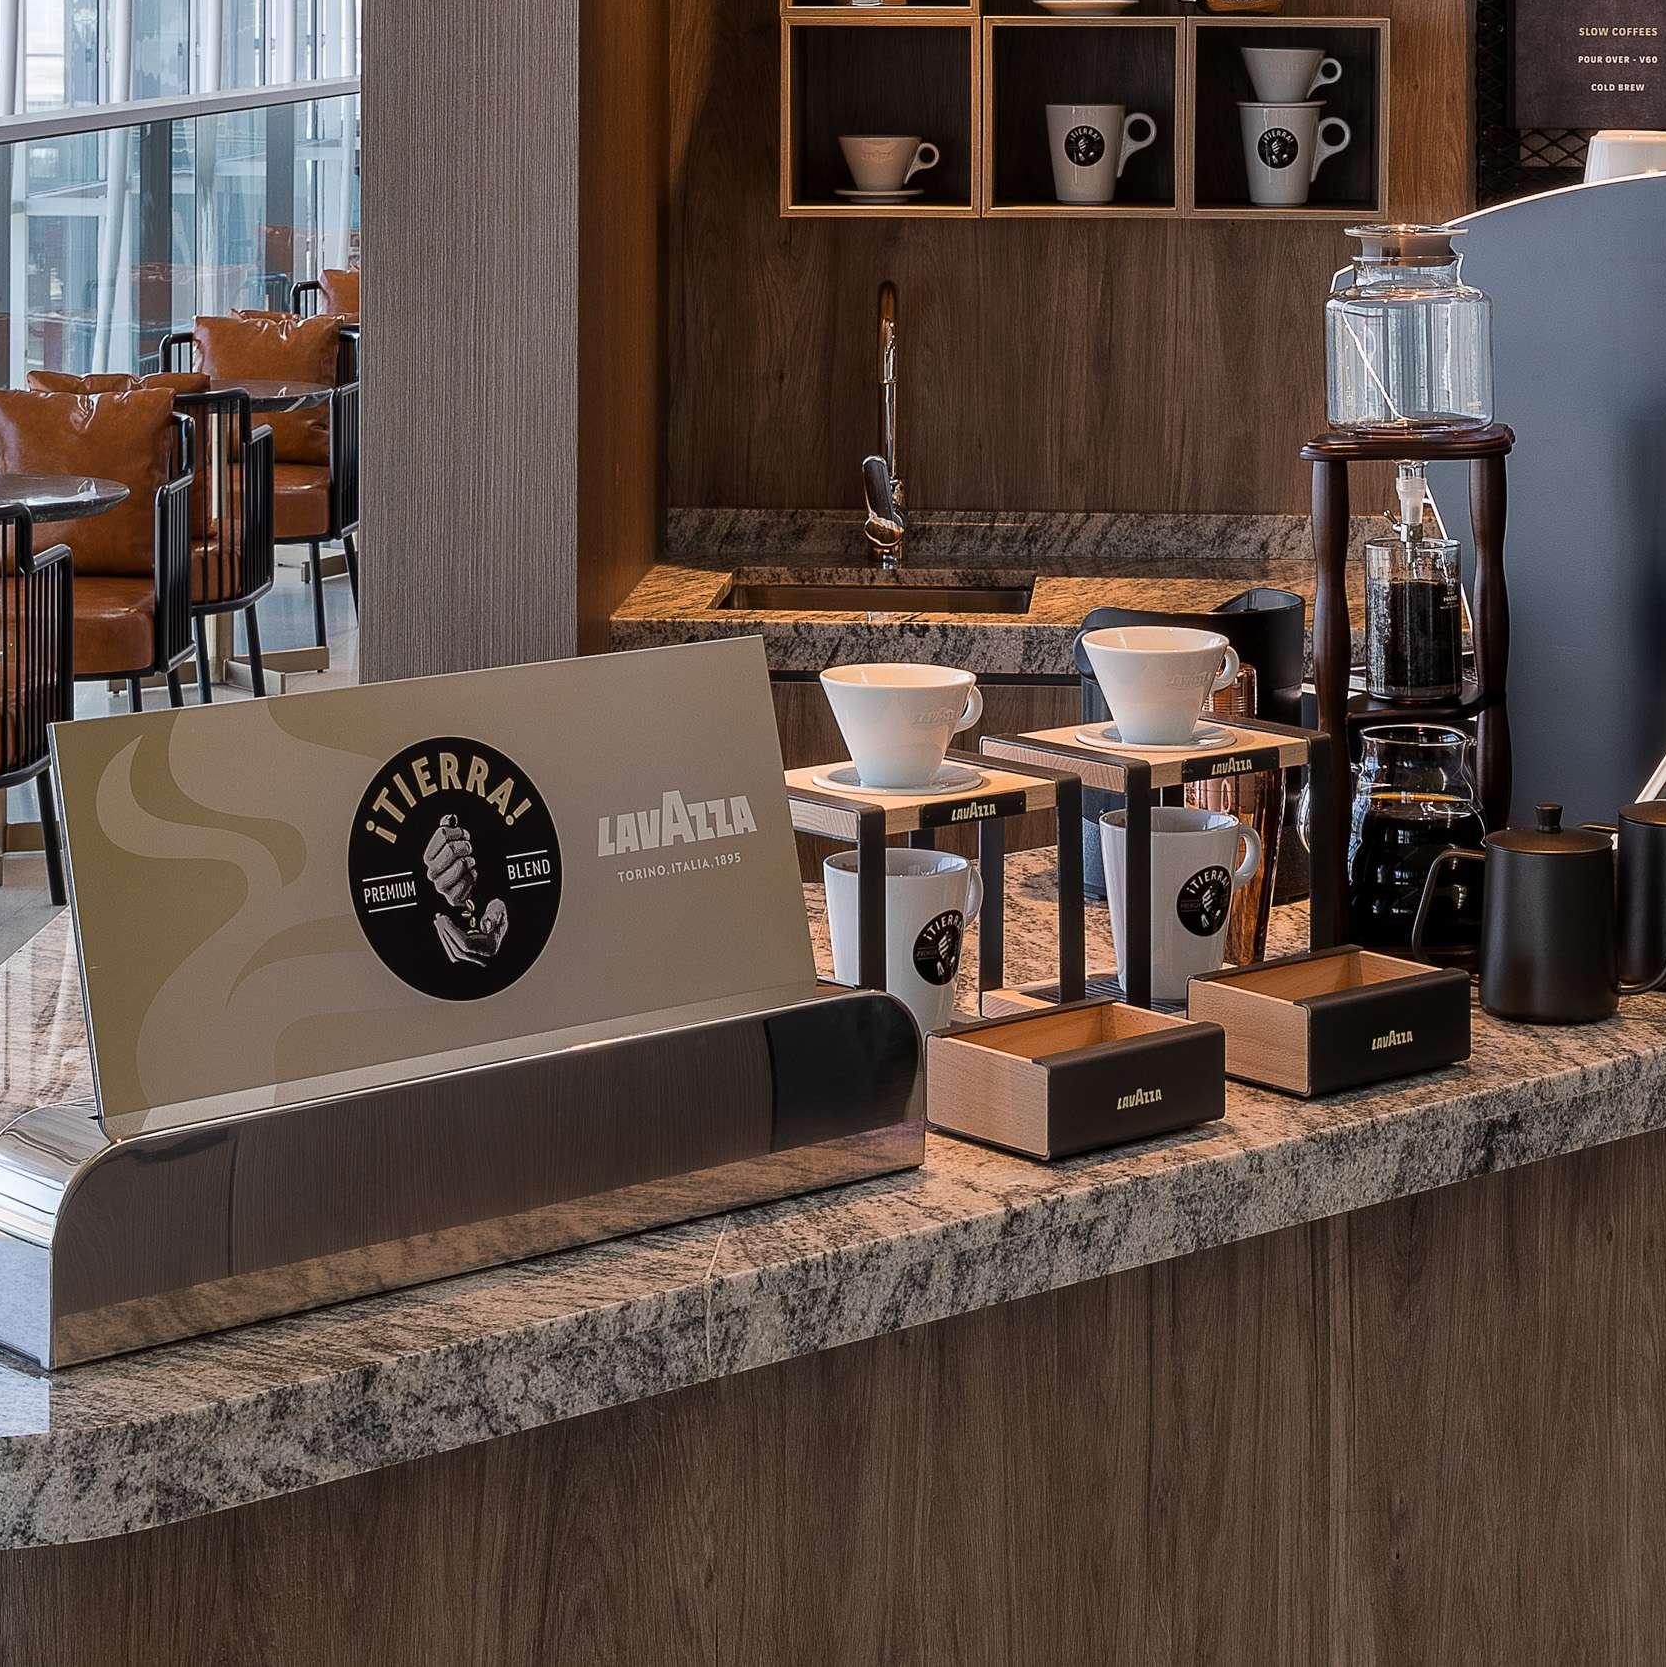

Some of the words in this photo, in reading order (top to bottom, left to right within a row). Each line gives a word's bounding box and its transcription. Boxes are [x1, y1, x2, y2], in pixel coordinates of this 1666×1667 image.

[1579, 27, 1608, 36] SLOW
[1612, 27, 1658, 36] COFFEES
[1578, 56, 1603, 64] POUR
[1605, 56, 1630, 64] OVER
[1639, 56, 1658, 64] V60
[1591, 83, 1615, 92] COLD
[1618, 83, 1645, 92] BREW
[1211, 757, 1253, 776] LAVAZZA
[951, 801, 997, 822] LAVAZZA
[597, 789, 758, 857] LAVAZZA
[507, 858, 552, 881] BLEND
[363, 880, 417, 905] PREMIUM
[1371, 1029, 1414, 1051] LAVAZZA
[1116, 1087, 1163, 1111] LAVAZZA
